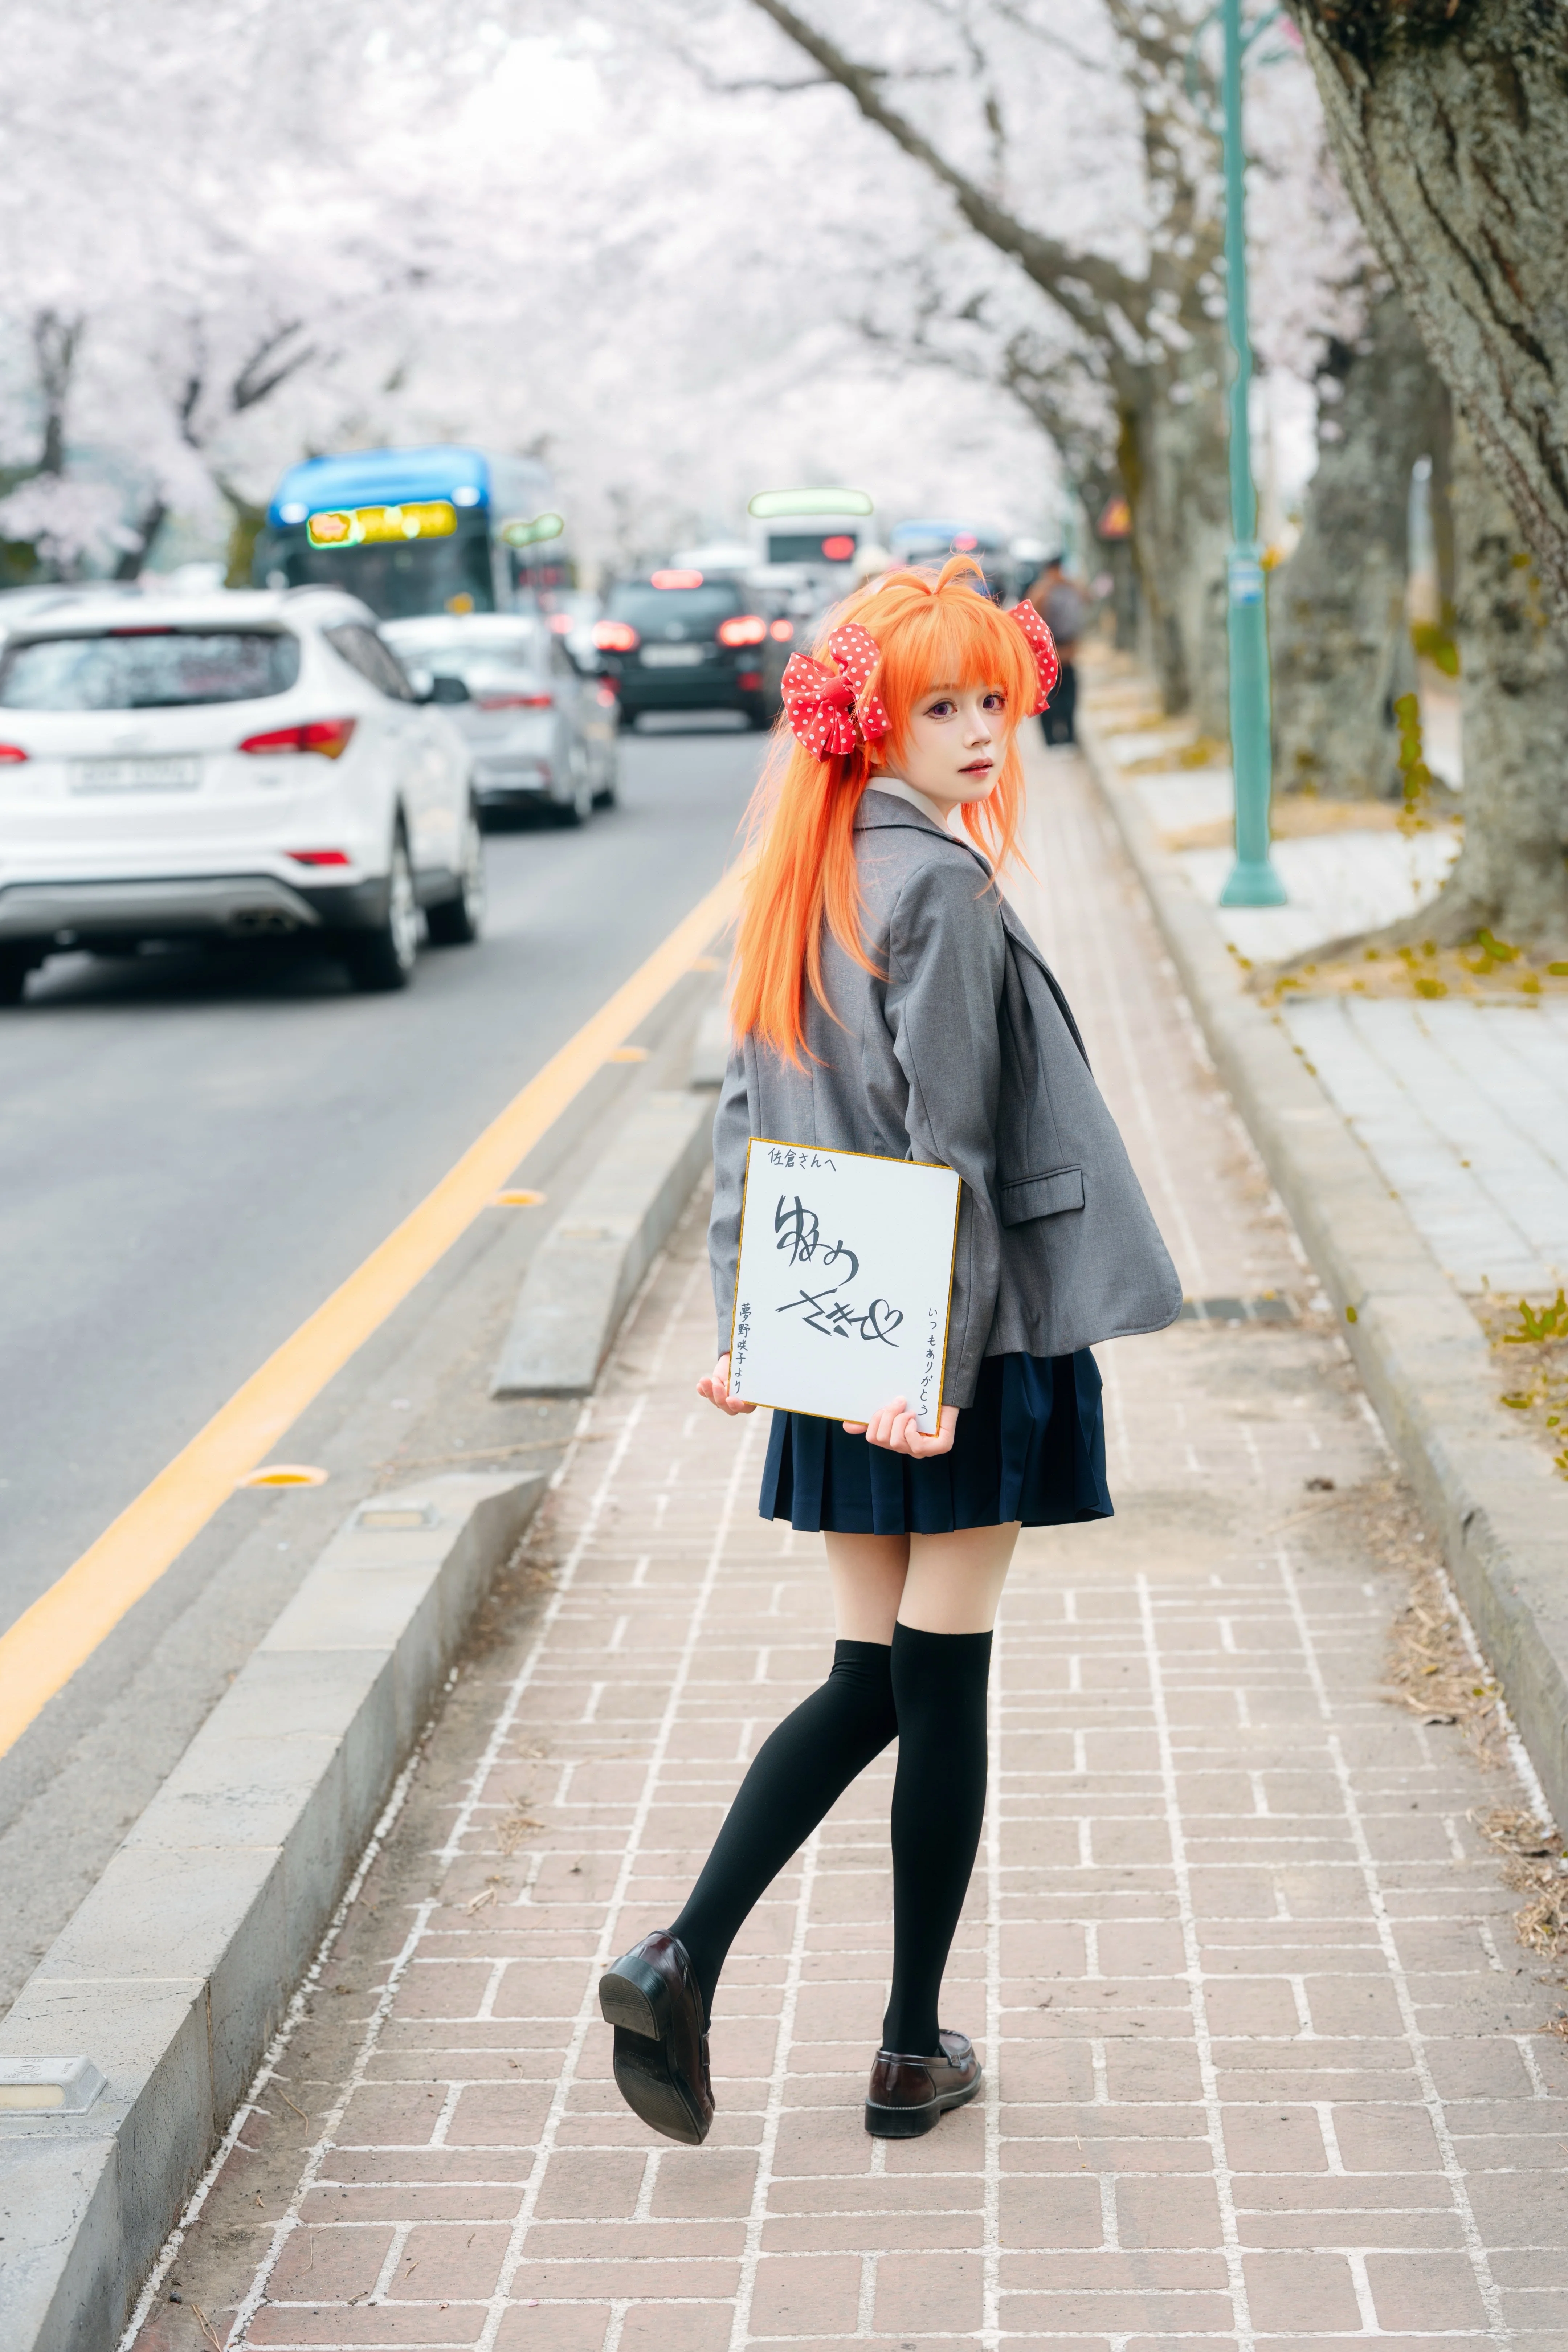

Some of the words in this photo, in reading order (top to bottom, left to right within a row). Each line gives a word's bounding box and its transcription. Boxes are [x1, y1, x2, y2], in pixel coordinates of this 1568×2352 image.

[768, 1147, 836, 1172] 佐倉さんへ
[735, 1302, 752, 1394] 夢野咲子より
[917, 1307, 938, 1416] いつもありがとう
